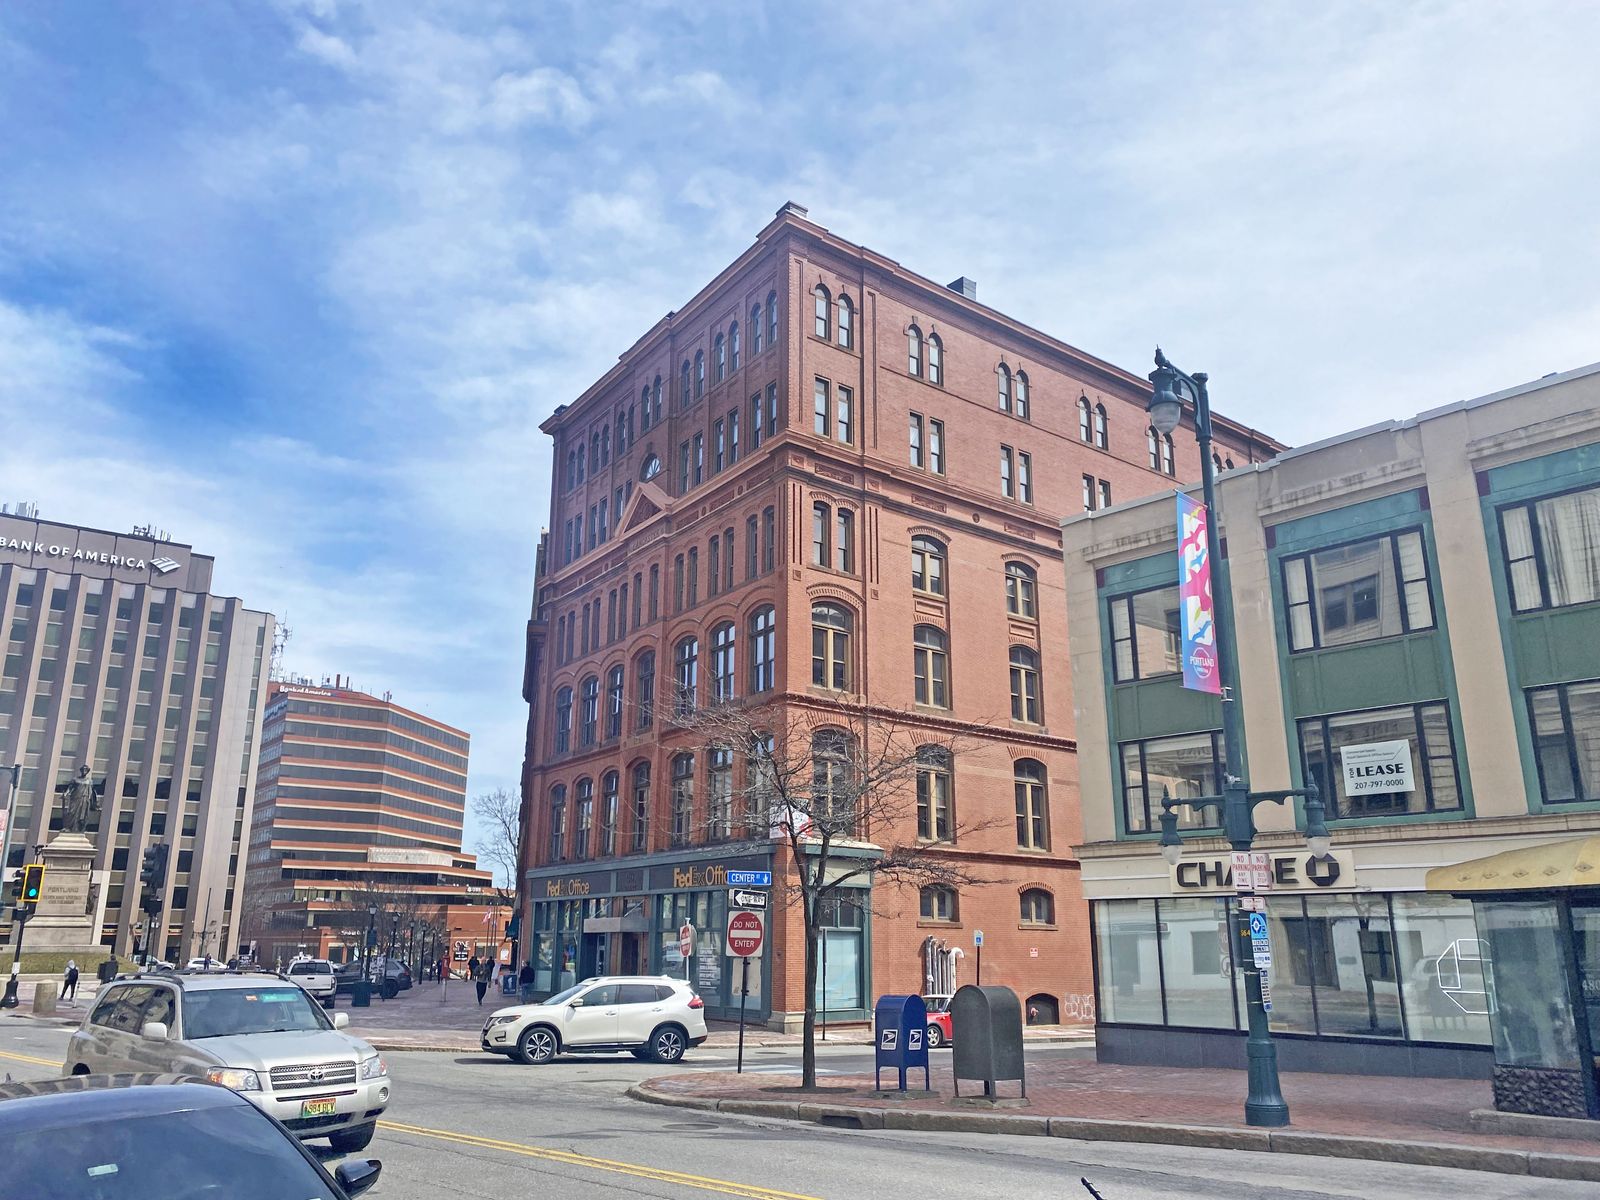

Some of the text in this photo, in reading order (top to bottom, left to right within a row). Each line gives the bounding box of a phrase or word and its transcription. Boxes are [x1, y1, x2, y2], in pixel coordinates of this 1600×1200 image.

[0, 536, 145, 570] BANK OF AMERICA
[1190, 655, 1214, 667] PORTLAND
[1356, 763, 1406, 778] LEASE
[1354, 779, 1404, 790] 207-797-0000
[1236, 855, 1245, 863] NO
[1255, 855, 1265, 863] NO
[673, 865, 728, 888] FedEx Offic
[731, 873, 755, 883] CENTER
[1176, 857, 1299, 888] CHE
[568, 879, 590, 896] Office
[741, 895, 764, 904] ONE WAY
[733, 921, 743, 929] DO
[734, 940, 755, 948] ENTER
